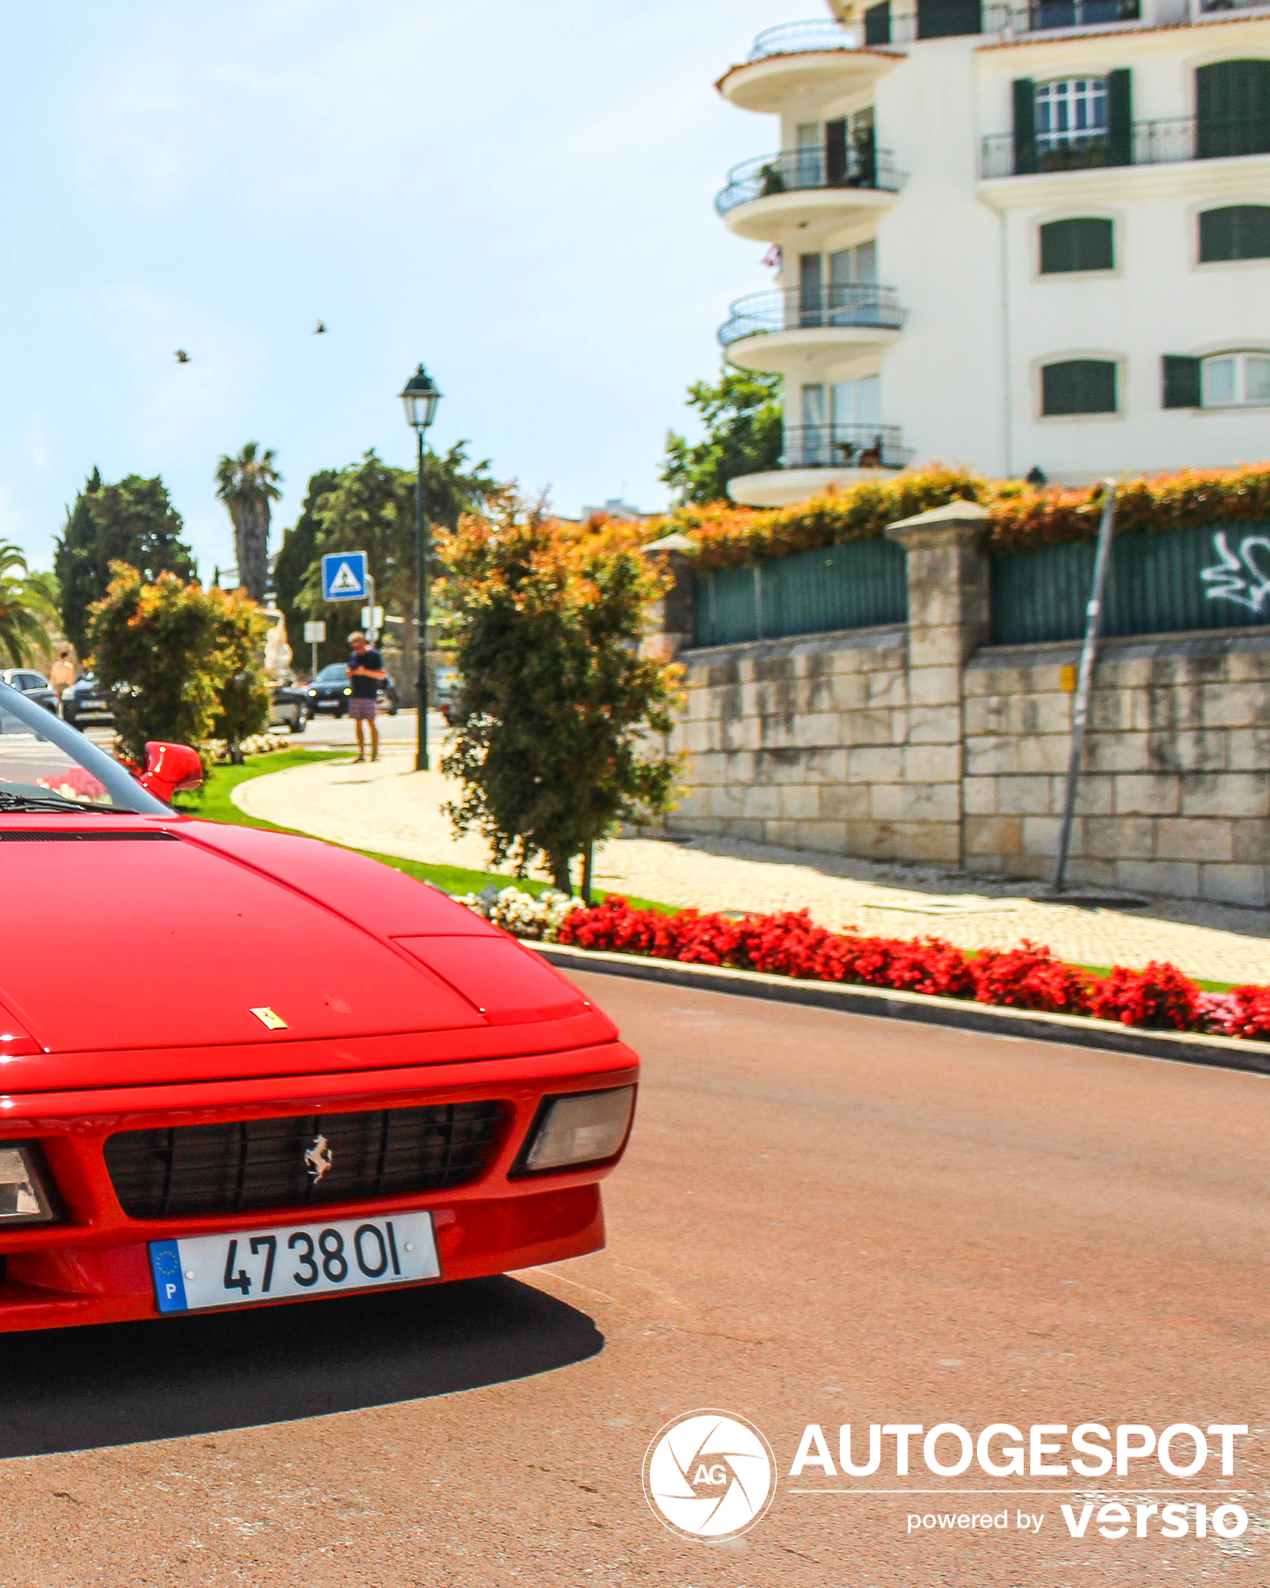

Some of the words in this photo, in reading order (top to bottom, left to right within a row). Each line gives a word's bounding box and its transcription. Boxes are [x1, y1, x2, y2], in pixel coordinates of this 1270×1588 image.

[223, 1234, 277, 1295] 47
[288, 1228, 348, 1287] 38
[164, 1283, 177, 1299] P
